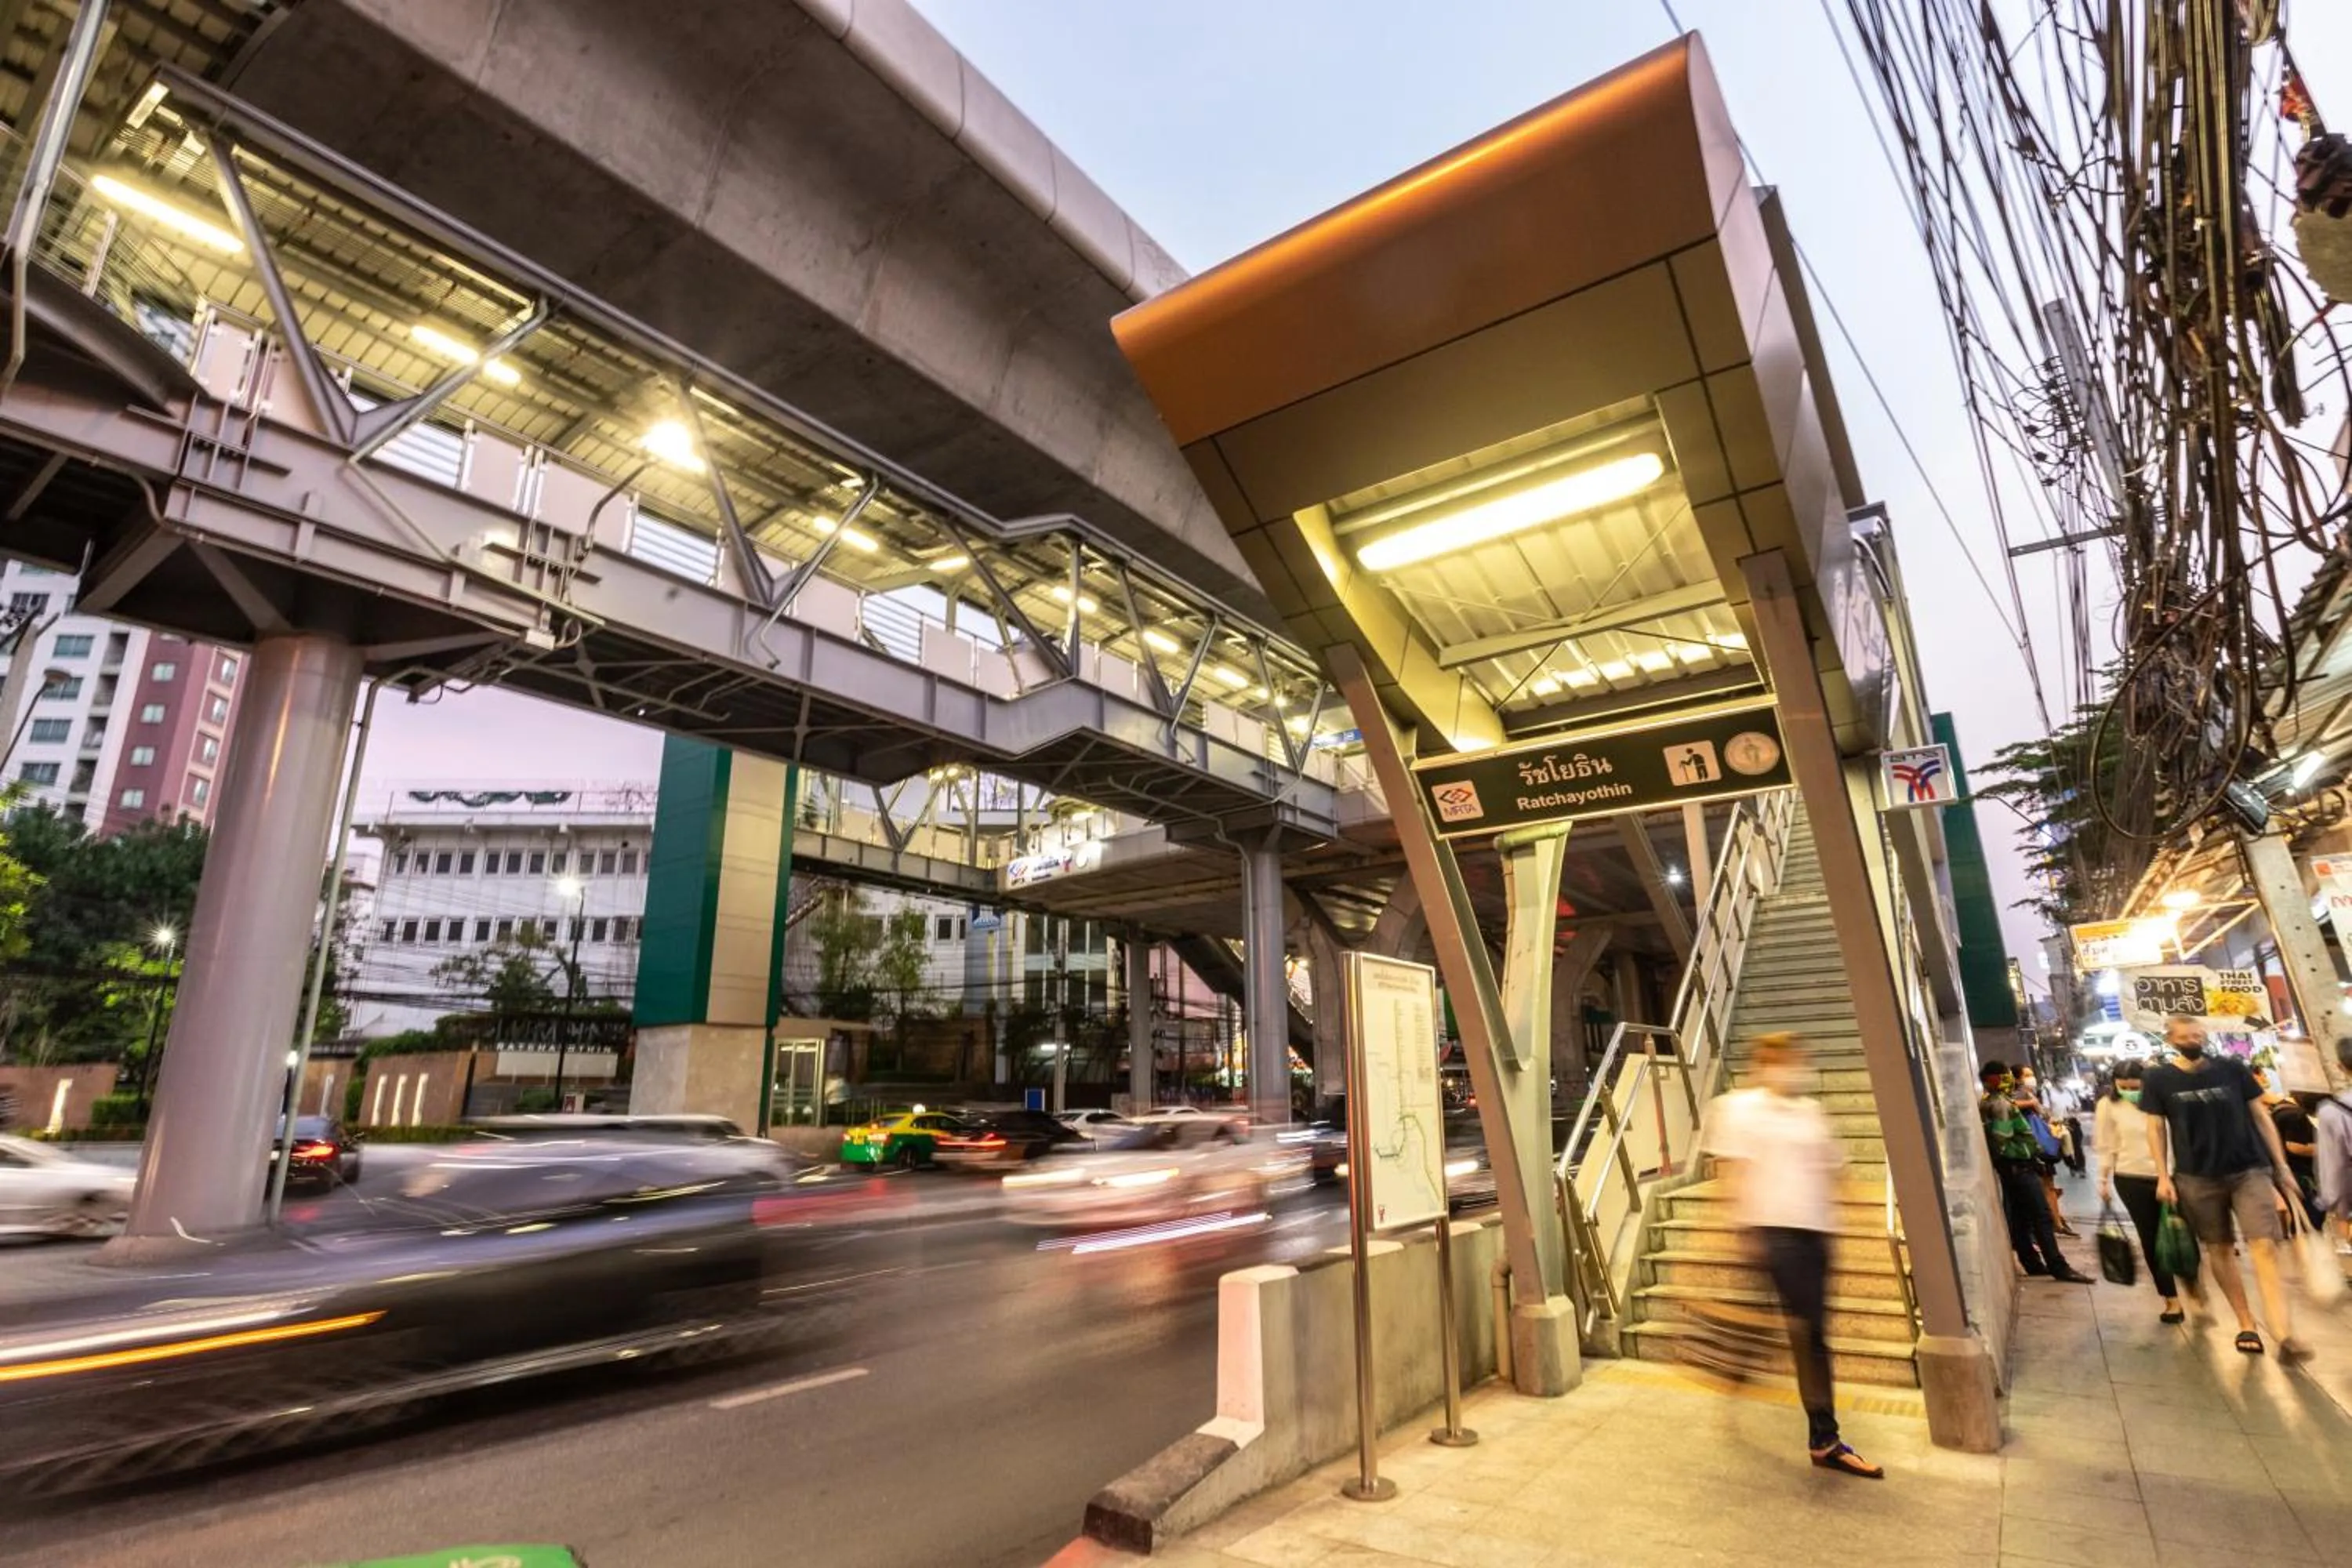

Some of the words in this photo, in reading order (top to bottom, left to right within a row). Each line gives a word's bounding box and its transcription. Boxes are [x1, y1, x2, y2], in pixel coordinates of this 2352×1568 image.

[1518, 753, 1613, 786] รัชโยธิน
[1516, 783, 1632, 811] Ratchayothin
[2136, 978, 2198, 994] อาหาร
[496, 1042, 612, 1054] RATCHAOTHIN
